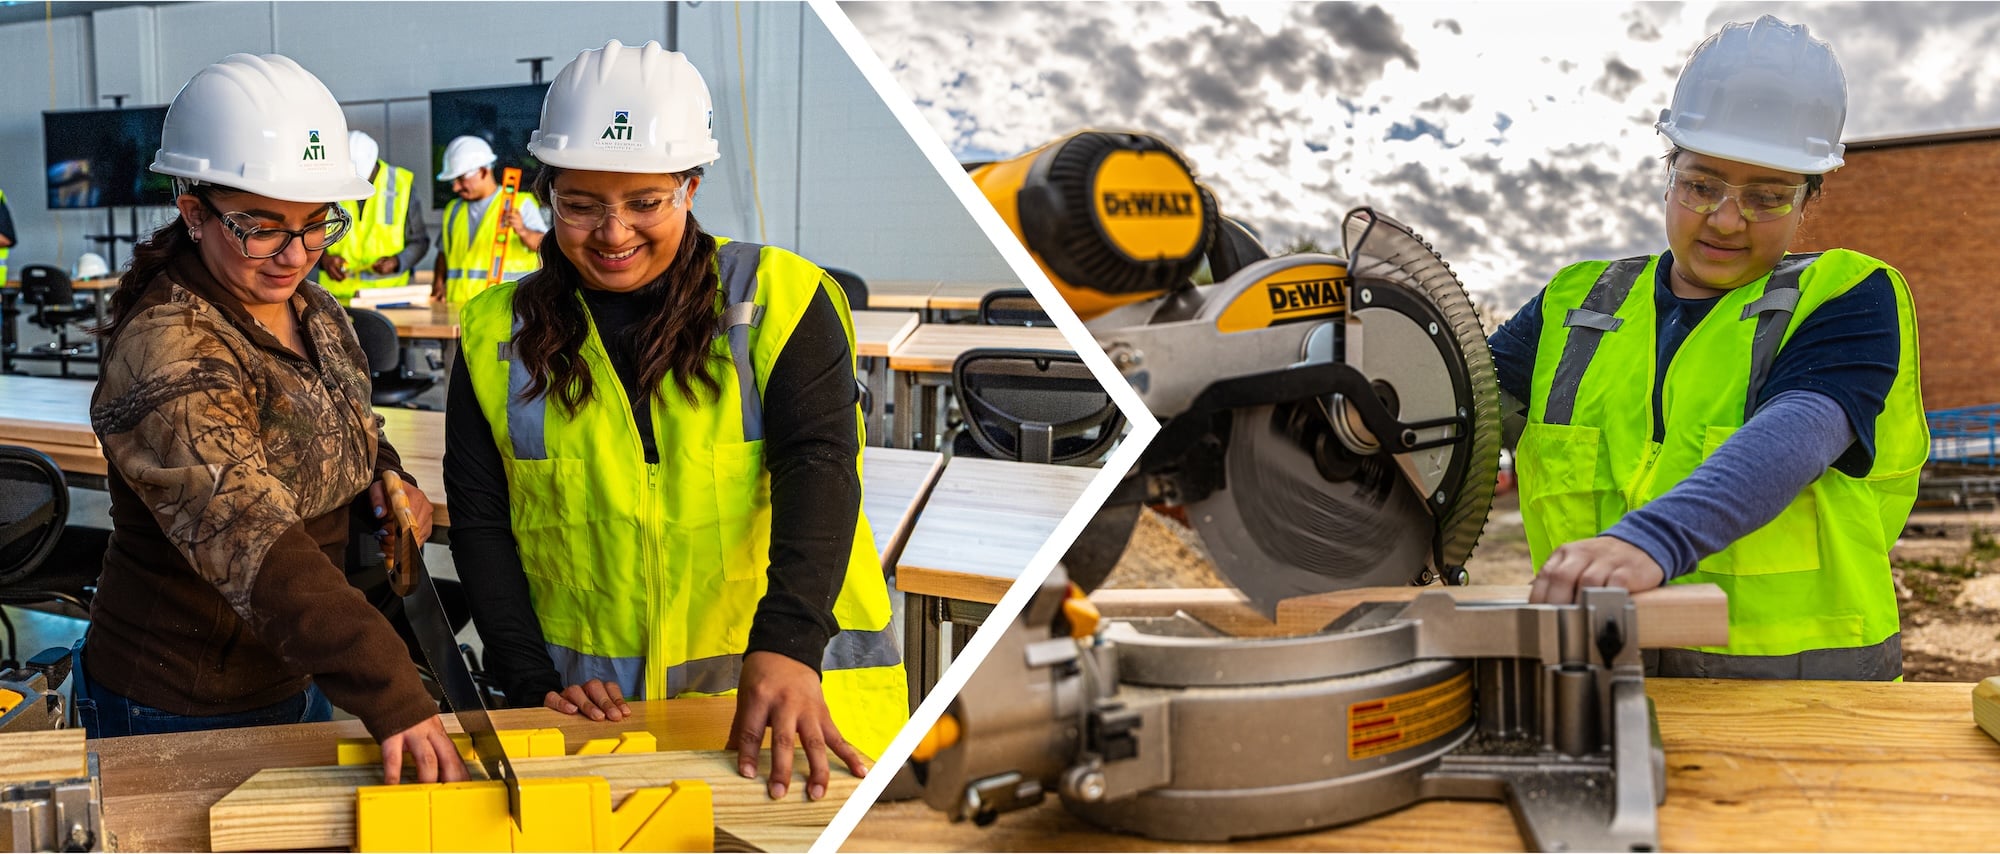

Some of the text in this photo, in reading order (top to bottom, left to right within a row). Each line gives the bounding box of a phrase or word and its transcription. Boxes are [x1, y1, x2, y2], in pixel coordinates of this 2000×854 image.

[601, 125, 633, 140] ATI
[302, 145, 325, 160] ATI
[1103, 191, 1195, 217] DEWALT
[1268, 279, 1351, 310] DEWAL
